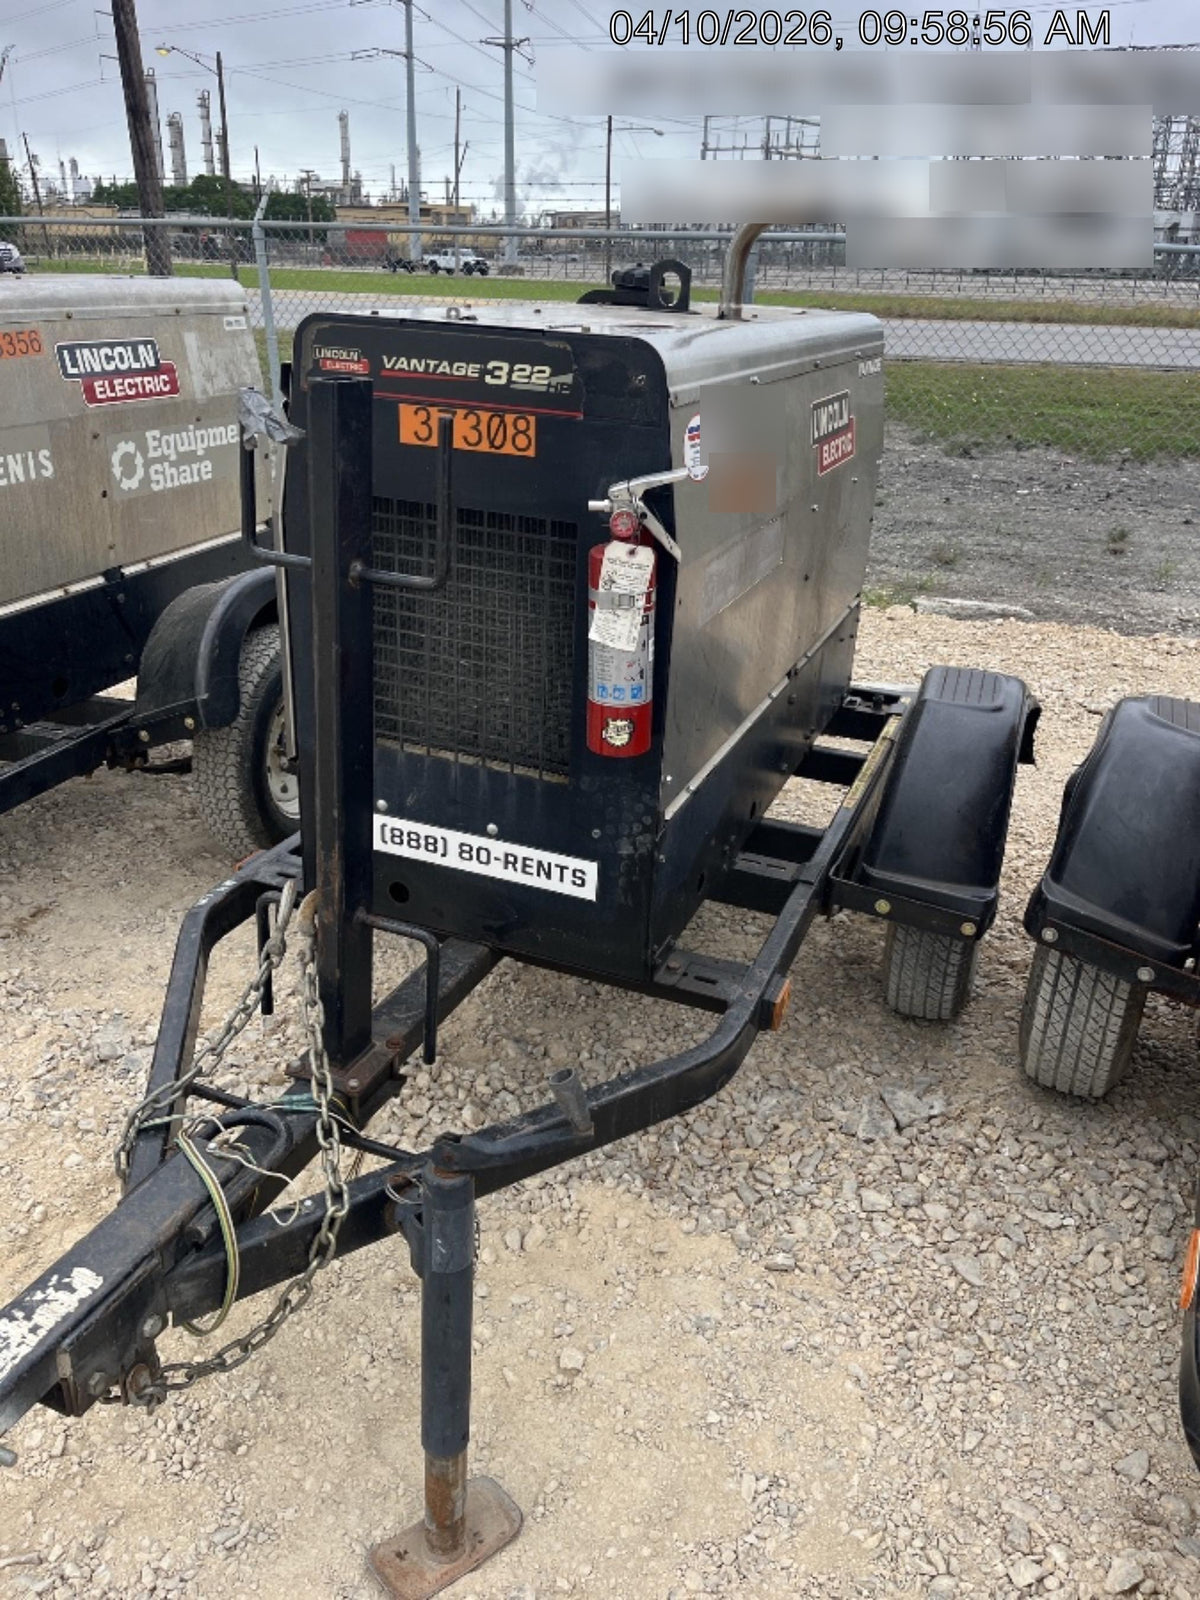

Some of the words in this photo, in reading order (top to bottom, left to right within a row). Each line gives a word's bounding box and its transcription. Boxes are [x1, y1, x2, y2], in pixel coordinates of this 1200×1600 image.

[0, 330, 42, 356] 356
[315, 347, 358, 361] LINCOLN
[63, 344, 156, 374] LINCOLN
[382, 355, 481, 378] VANTAGE
[485, 361, 552, 385] 322
[93, 374, 171, 399] ELECTRIC
[146, 423, 240, 461] Equipme
[149, 460, 213, 491] Share
[380, 822, 448, 858] (888)
[458, 842, 587, 888] 80-RENTS
